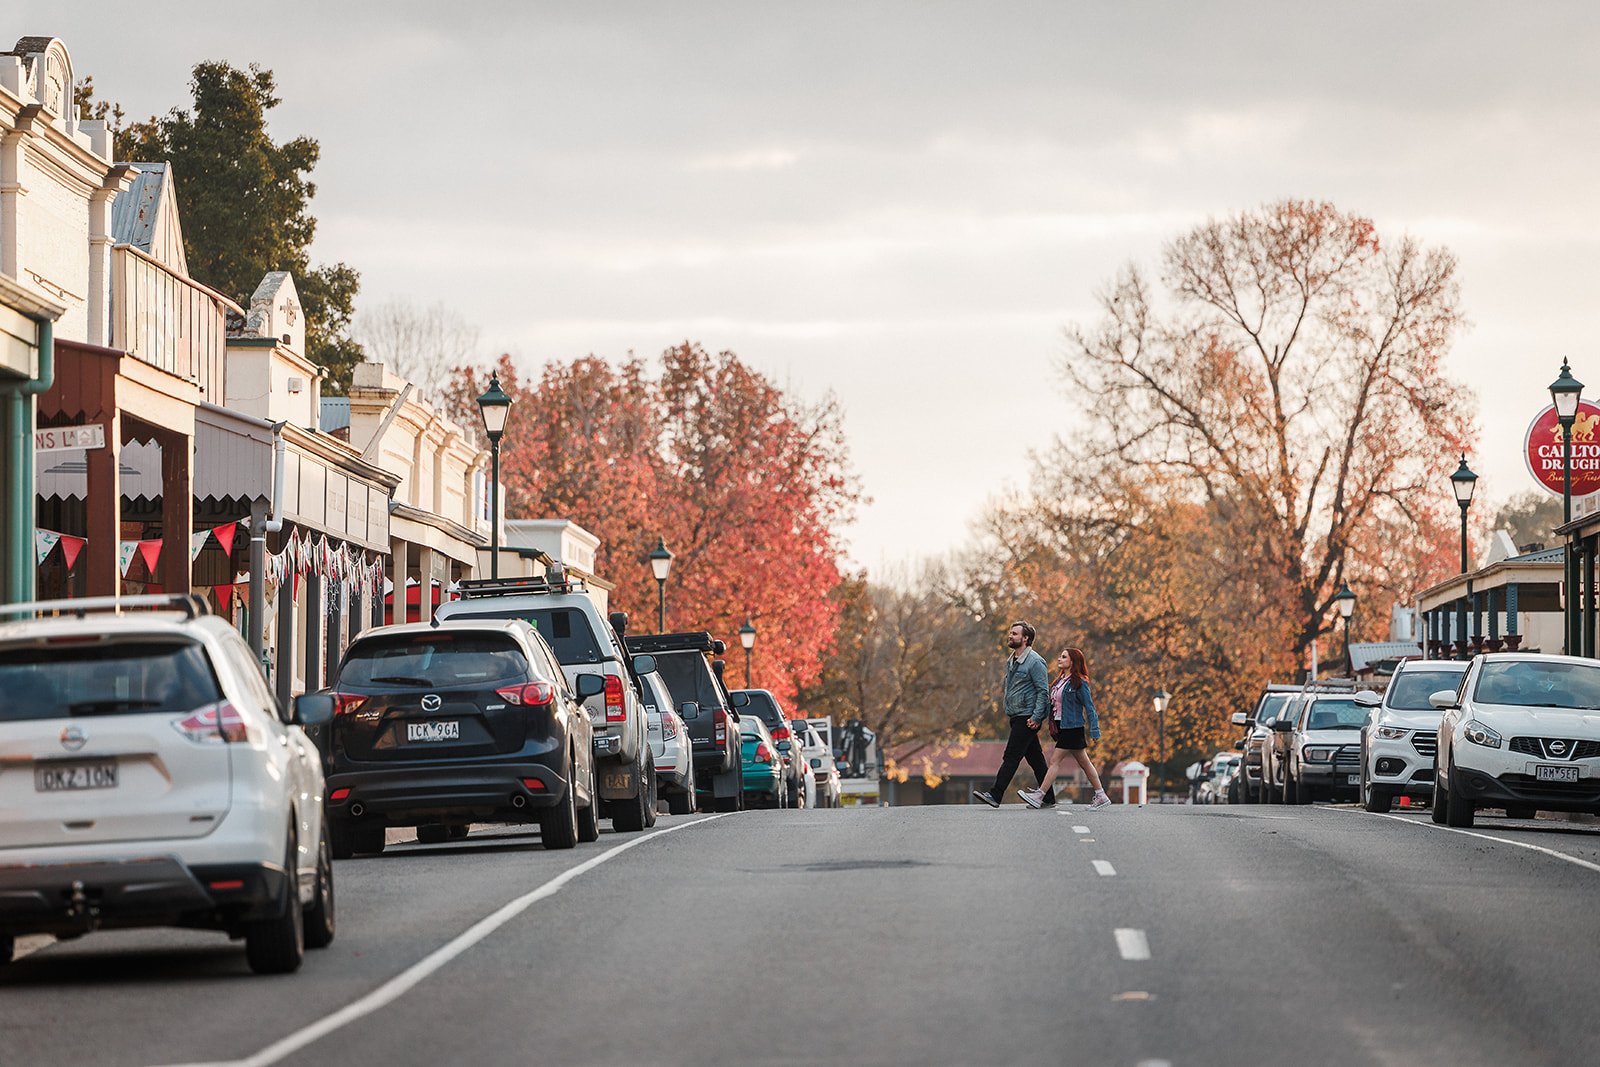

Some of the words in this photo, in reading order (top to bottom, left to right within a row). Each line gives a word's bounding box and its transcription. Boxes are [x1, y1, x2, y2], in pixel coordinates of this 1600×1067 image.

[1538, 445, 1600, 457] CALTO
[1542, 459, 1599, 470] DRUGH
[411, 725, 429, 737] 1CK
[437, 723, 458, 736] 9GA
[605, 773, 632, 789] CAT
